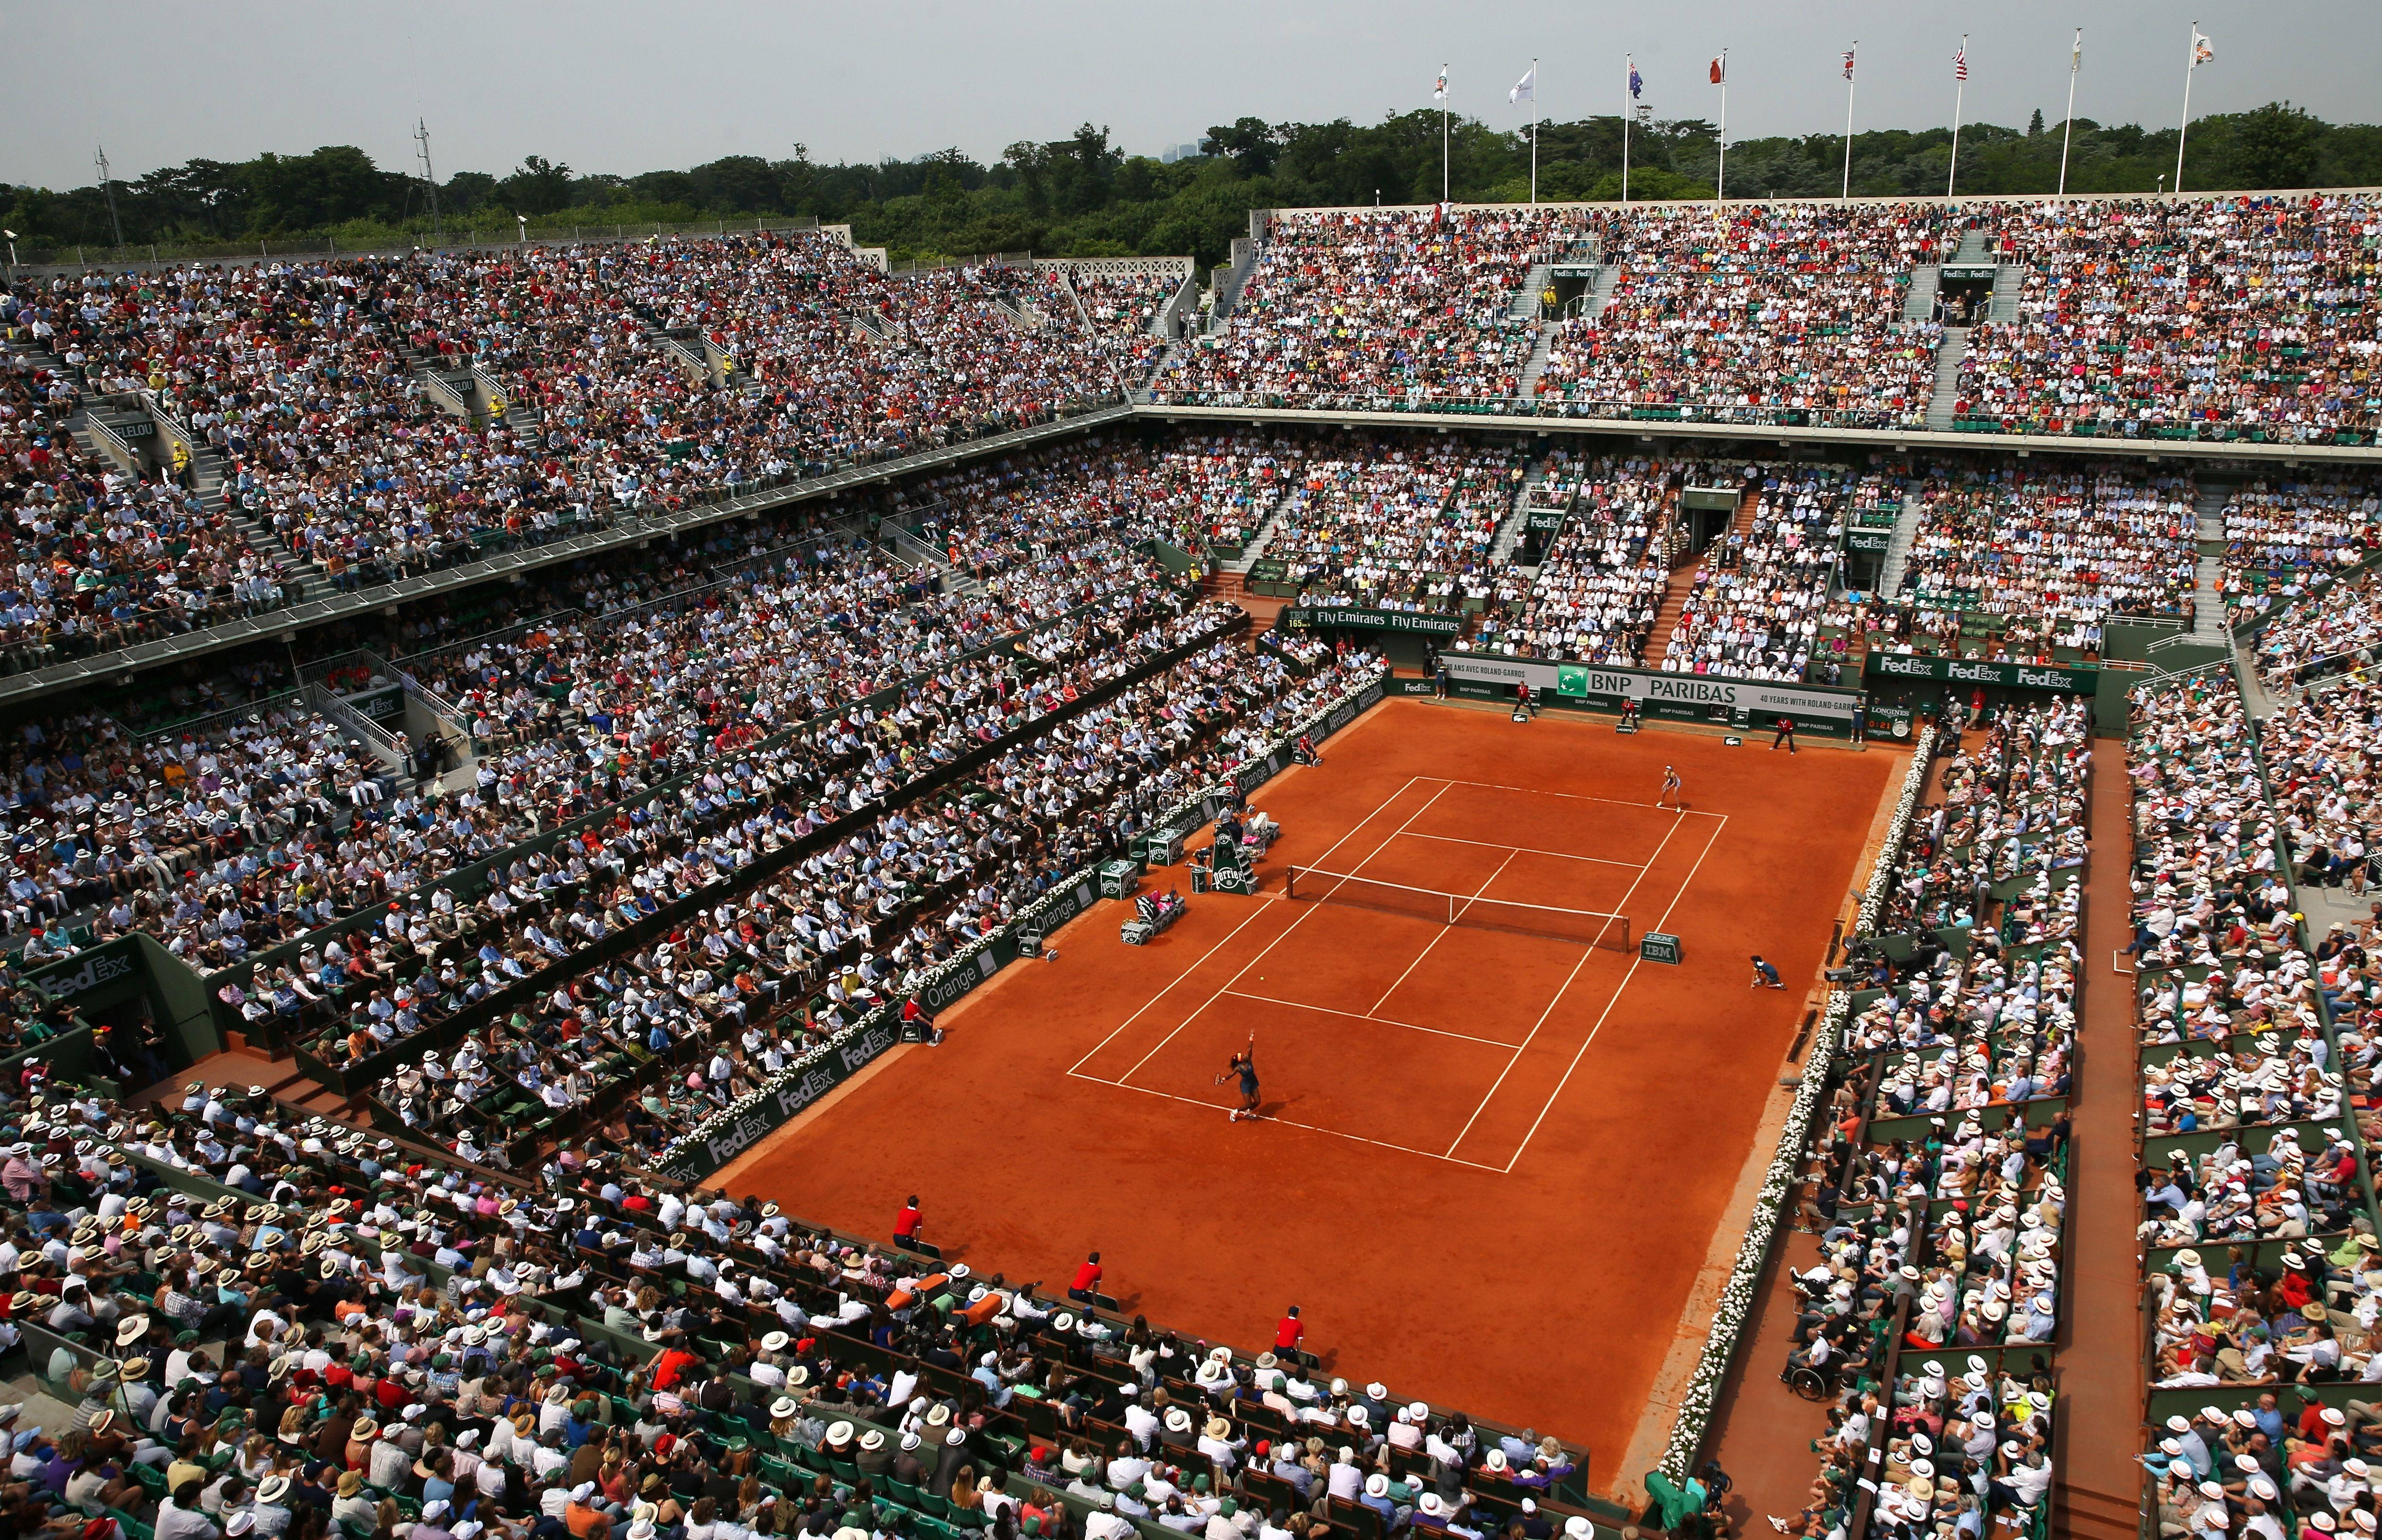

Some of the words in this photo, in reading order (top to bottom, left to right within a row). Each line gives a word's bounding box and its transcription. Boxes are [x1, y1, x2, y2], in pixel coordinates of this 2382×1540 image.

[1849, 535, 1888, 549] FedEx
[1290, 611, 1310, 619] IBM
[1318, 612, 1336, 624] Fly
[1338, 612, 1385, 626] Emirates
[1392, 616, 1410, 629] Fly
[1412, 617, 1460, 632] Emirates
[1289, 619, 1302, 627] 165
[1480, 667, 1525, 678] ROLAND-GARROS
[1881, 656, 1932, 675] FedEx
[1948, 662, 2001, 681] FedEx
[2017, 668, 2072, 688] FedEx
[1405, 684, 1430, 692] FedEx
[1591, 674, 1632, 693] BNP
[1650, 680, 1735, 703] PARIBAS
[1328, 703, 1355, 730] AFFLELOU
[1358, 684, 1383, 710] AFFLELOU
[1760, 694, 1768, 702] 40
[1769, 696, 1789, 705] YEARS
[1790, 698, 1806, 707] WITH
[1872, 707, 1909, 716] LONGINES
[1869, 720, 1890, 729] 0:21
[1239, 765, 1267, 791] Orange
[1035, 899, 1075, 932] Orange
[1647, 934, 1673, 942] IBM
[1645, 944, 1670, 958] IBM
[39, 955, 132, 997] FedEx
[928, 967, 976, 1007] Orange
[707, 1113, 771, 1165] FedEx
[777, 1068, 835, 1116] FedEx
[840, 1027, 893, 1072] FedEx
